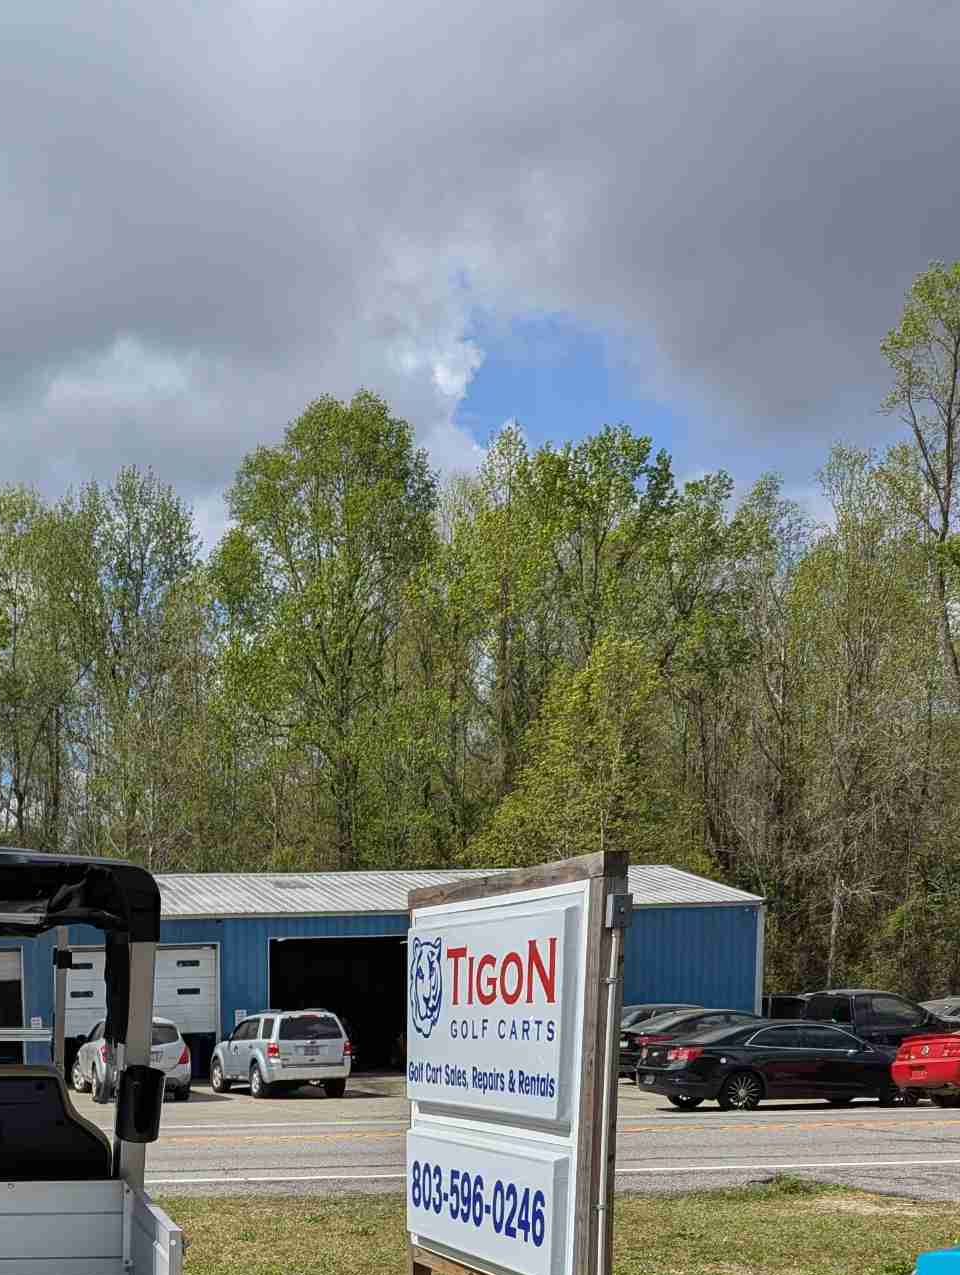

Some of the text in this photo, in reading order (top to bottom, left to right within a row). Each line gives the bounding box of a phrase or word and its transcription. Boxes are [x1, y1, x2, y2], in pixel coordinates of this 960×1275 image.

[446, 937, 558, 1006] TIGON
[450, 1019, 556, 1042] GOLF CARTS
[408, 1061, 556, 1098] Golf Cart Sales, Repairs & Rentals
[411, 1160, 546, 1248] 803-596-0246
